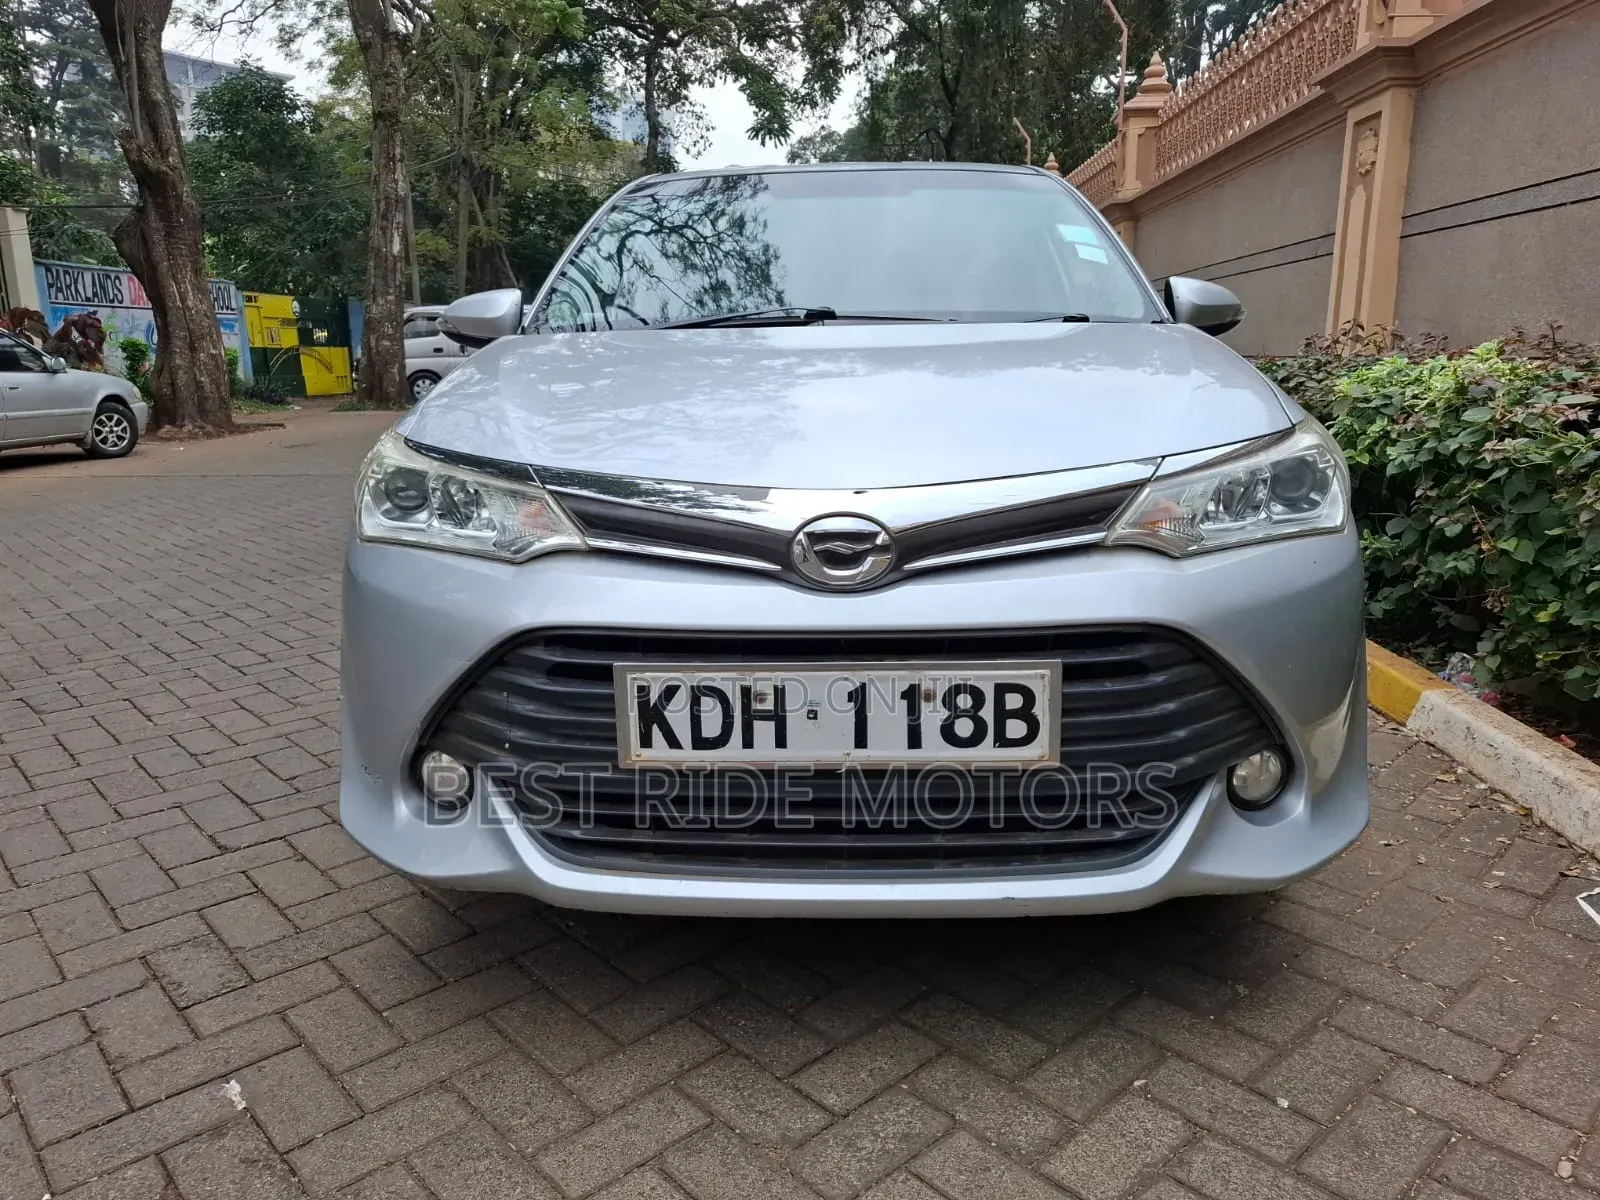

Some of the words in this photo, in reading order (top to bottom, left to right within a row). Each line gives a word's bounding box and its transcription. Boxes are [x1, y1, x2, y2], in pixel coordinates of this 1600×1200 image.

[46, 266, 124, 304] PARKLANDS
[127, 275, 149, 306] DA
[209, 283, 236, 311] HOOL
[636, 684, 788, 750] KDH
[847, 682, 1040, 750] 118B
